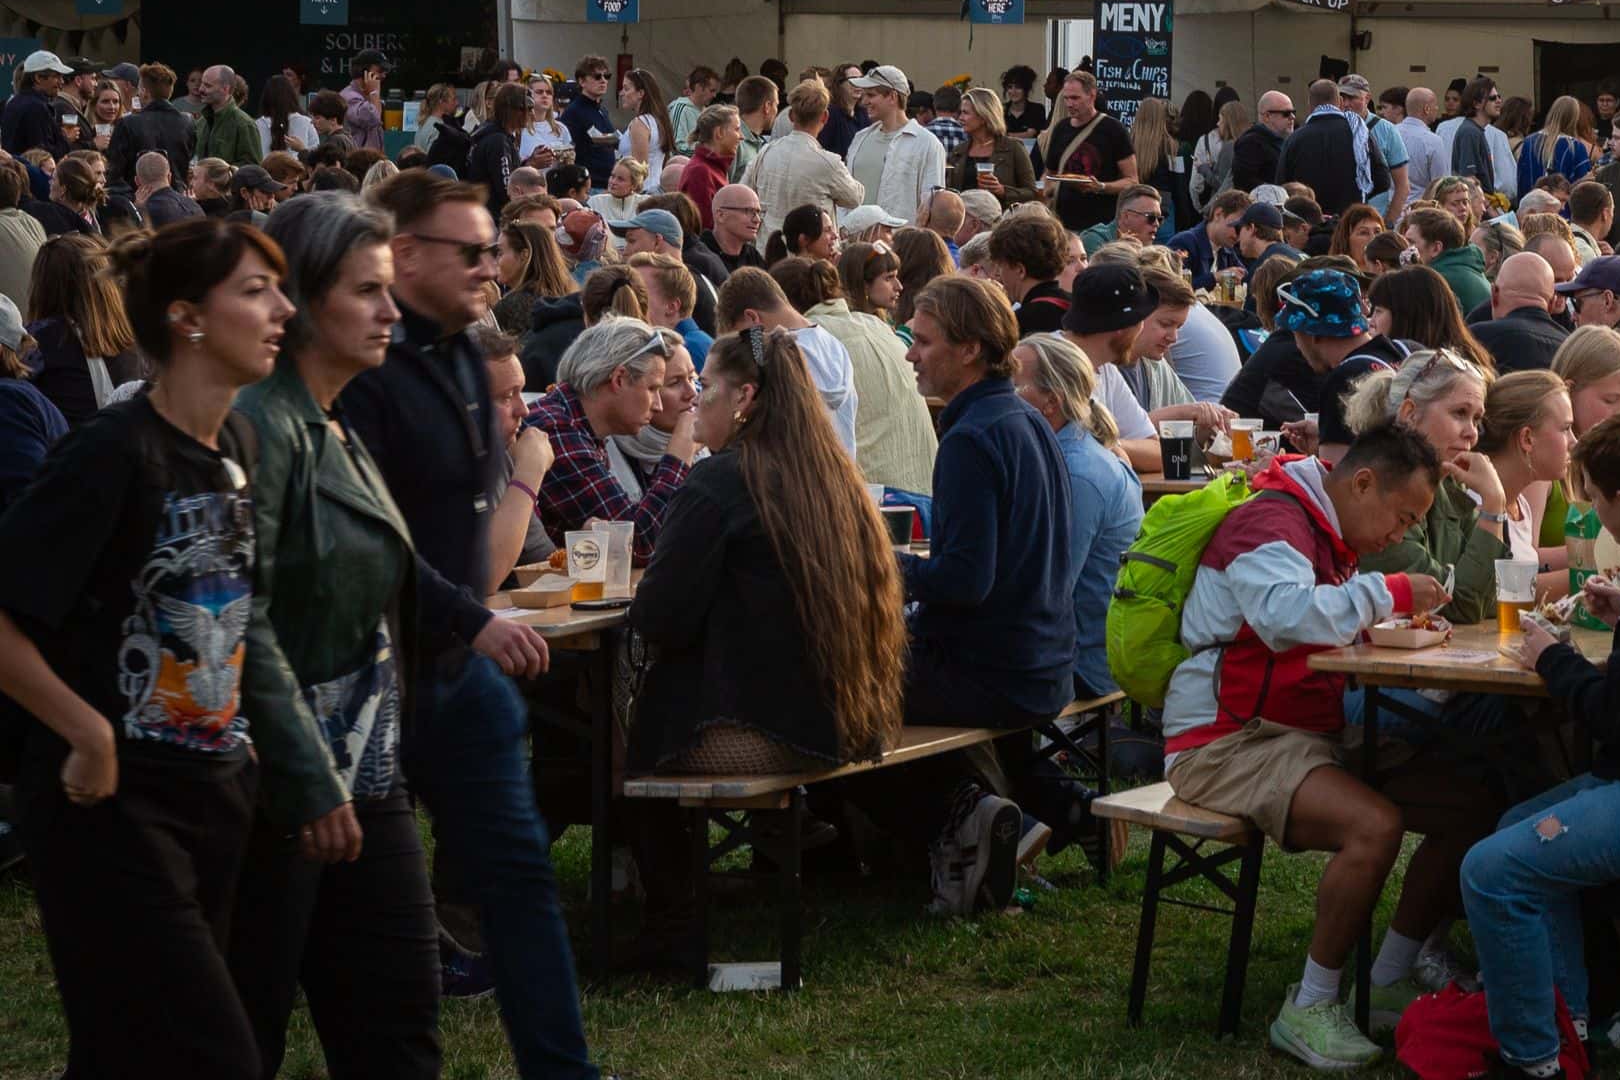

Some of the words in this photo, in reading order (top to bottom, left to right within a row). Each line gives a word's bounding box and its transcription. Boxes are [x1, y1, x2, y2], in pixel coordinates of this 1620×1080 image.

[604, 1, 621, 12] FOOD
[988, 3, 1006, 13] HERE
[1101, 2, 1165, 32] MENY
